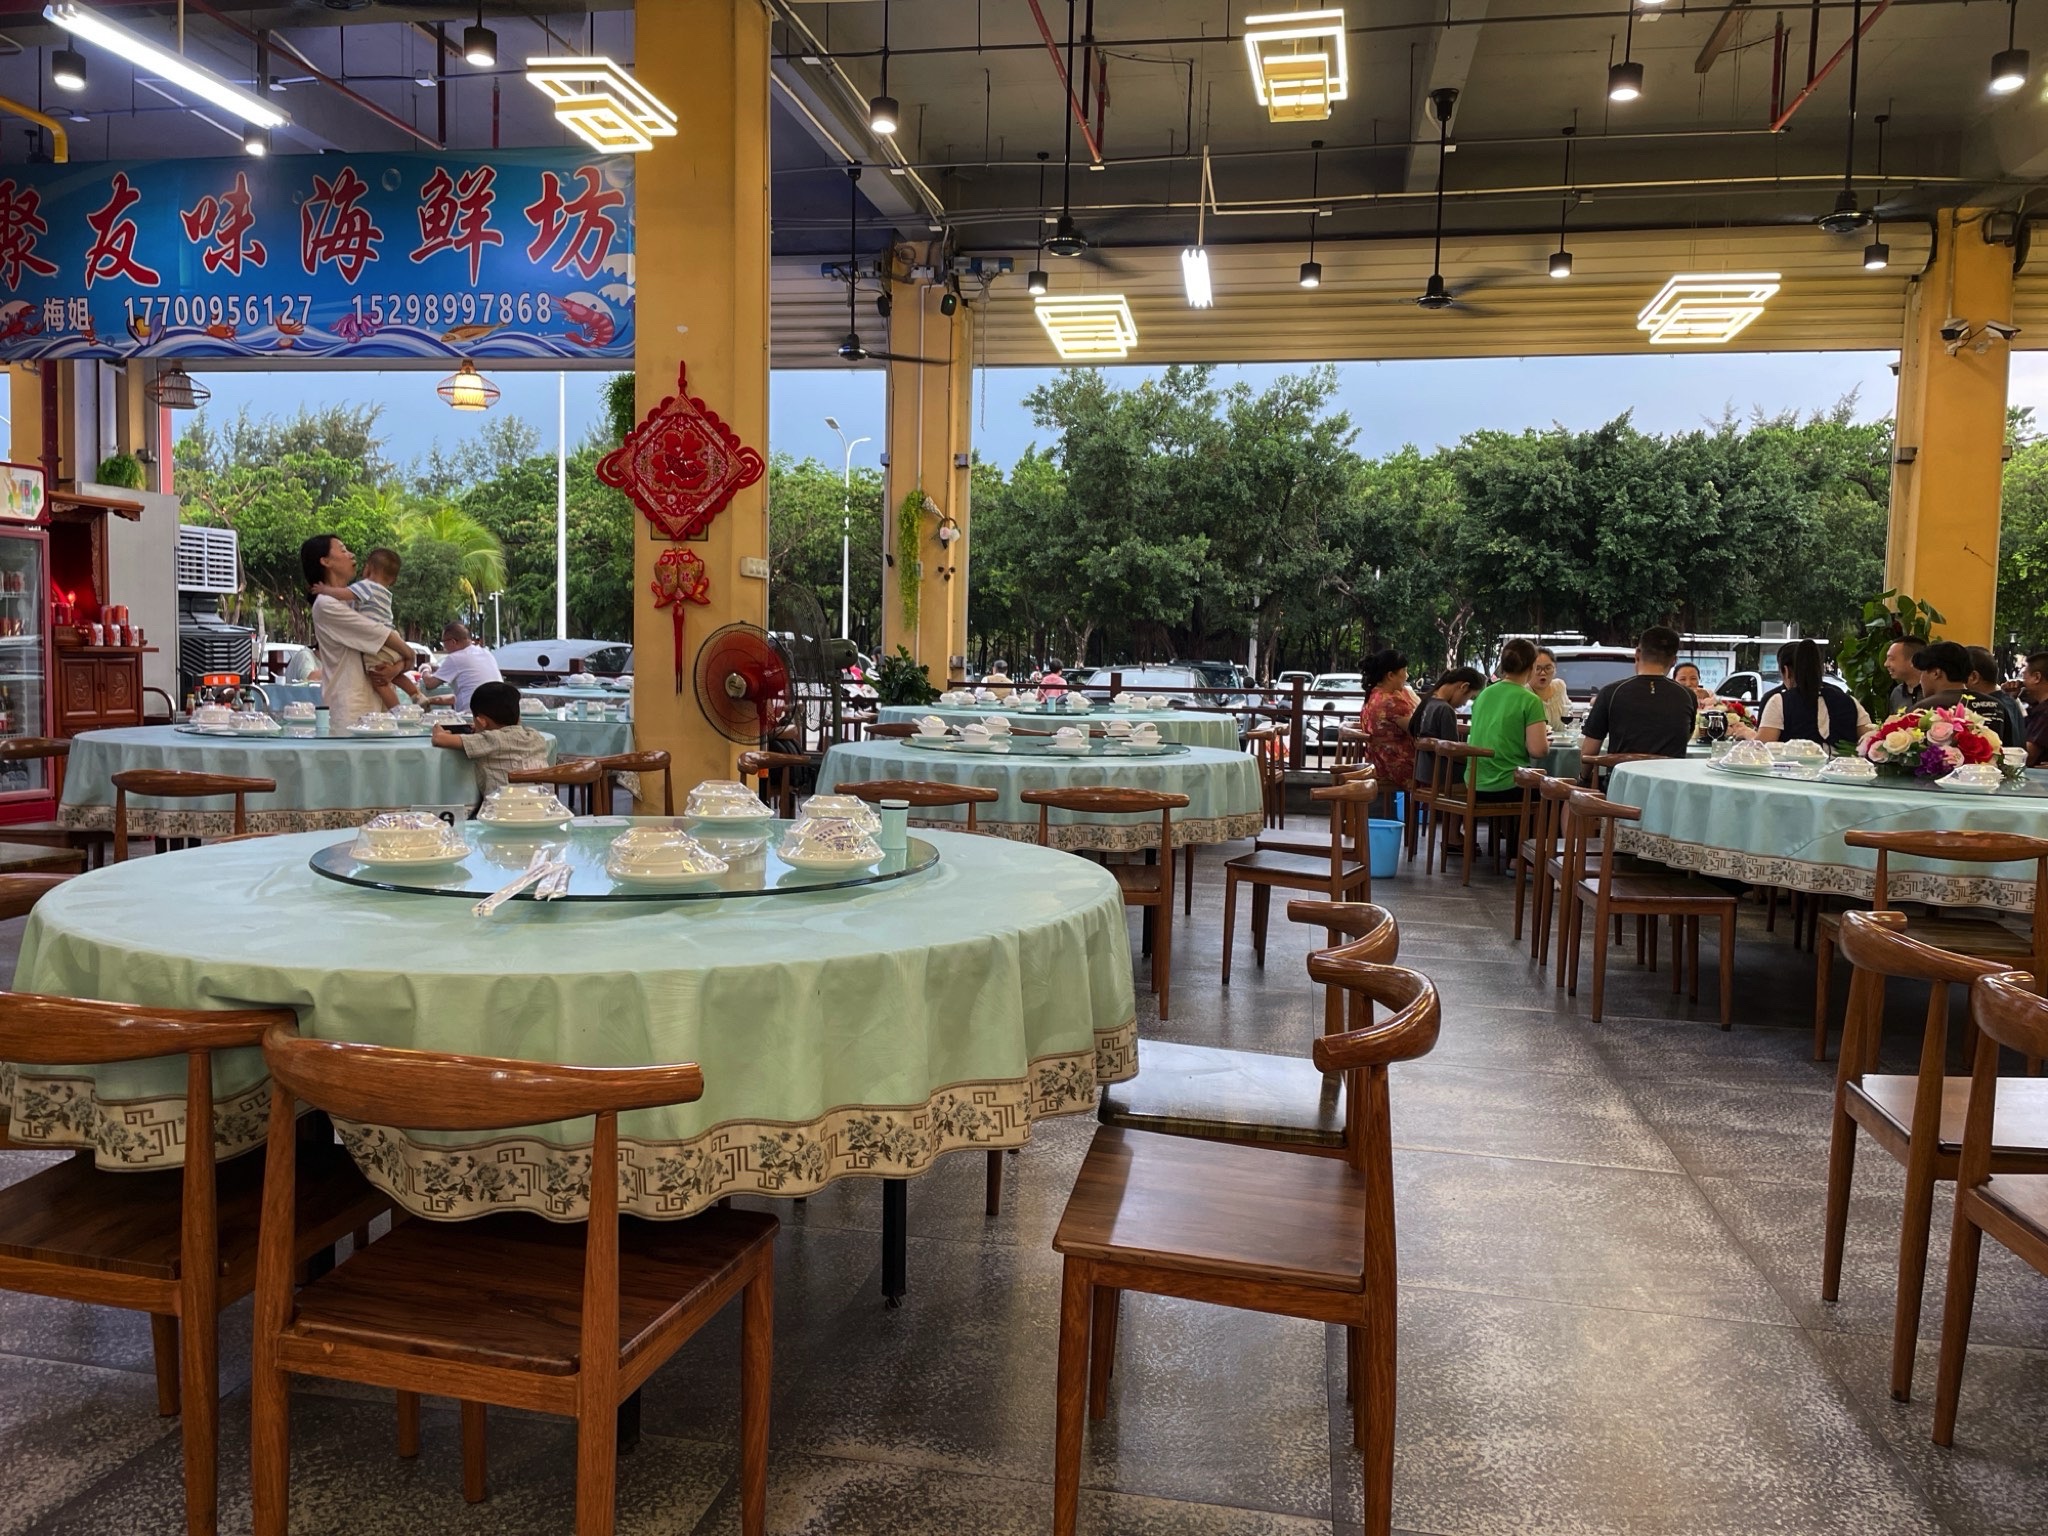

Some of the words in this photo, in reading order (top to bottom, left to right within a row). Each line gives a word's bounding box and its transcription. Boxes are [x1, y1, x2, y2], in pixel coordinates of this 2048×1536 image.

[0, 166, 626, 291] 聚友味海鲜坊
[43, 297, 91, 332] 梅姐
[124, 296, 312, 326] 17700956127
[352, 292, 552, 325] 15298997868
